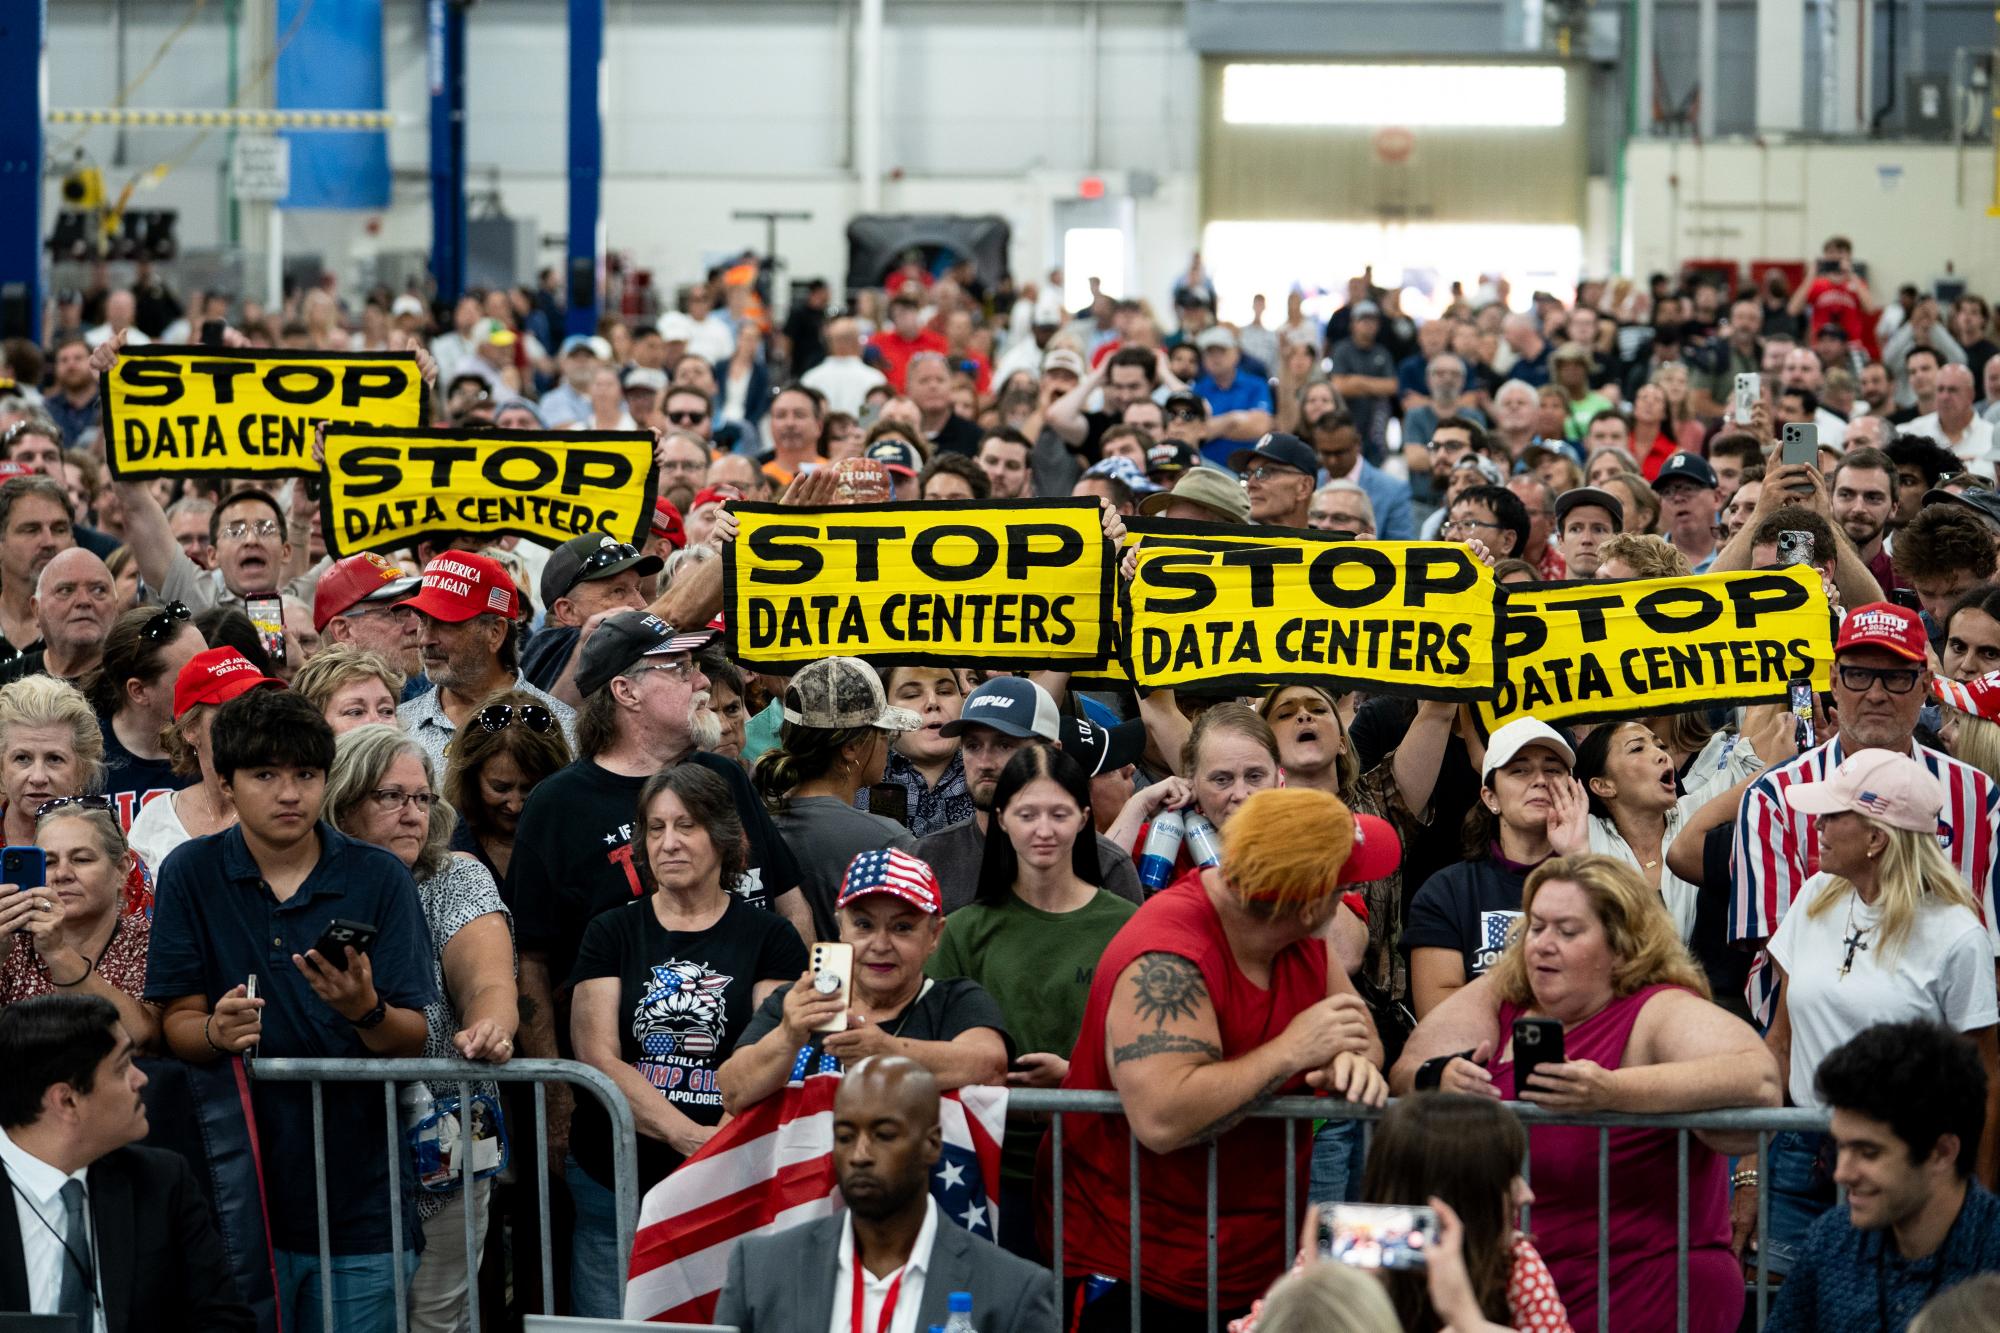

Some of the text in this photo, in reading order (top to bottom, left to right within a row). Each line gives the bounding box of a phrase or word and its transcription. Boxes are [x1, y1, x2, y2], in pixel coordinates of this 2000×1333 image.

[120, 359, 408, 407] STOP
[124, 415, 228, 462] DATA
[338, 446, 633, 498] STOP
[840, 470, 883, 481] TRUMP
[344, 496, 447, 544] DATA
[440, 559, 481, 583] AMERICA
[748, 523, 1085, 585] STOP
[437, 576, 471, 598] AGAIN
[1141, 546, 1479, 614] STOP
[749, 595, 870, 649] DATA
[879, 593, 1076, 646] CENTERS
[1852, 612, 1909, 632] Trump
[1142, 620, 1263, 675] DATA
[1275, 617, 1472, 675] CENTERS
[970, 695, 1015, 709] MPW
[1493, 638, 1816, 719] DATA CENTERS
[666, 1054, 695, 1067] STILL
[695, 1058, 704, 1066] A
[668, 1090, 723, 1105] APOLOGIES
